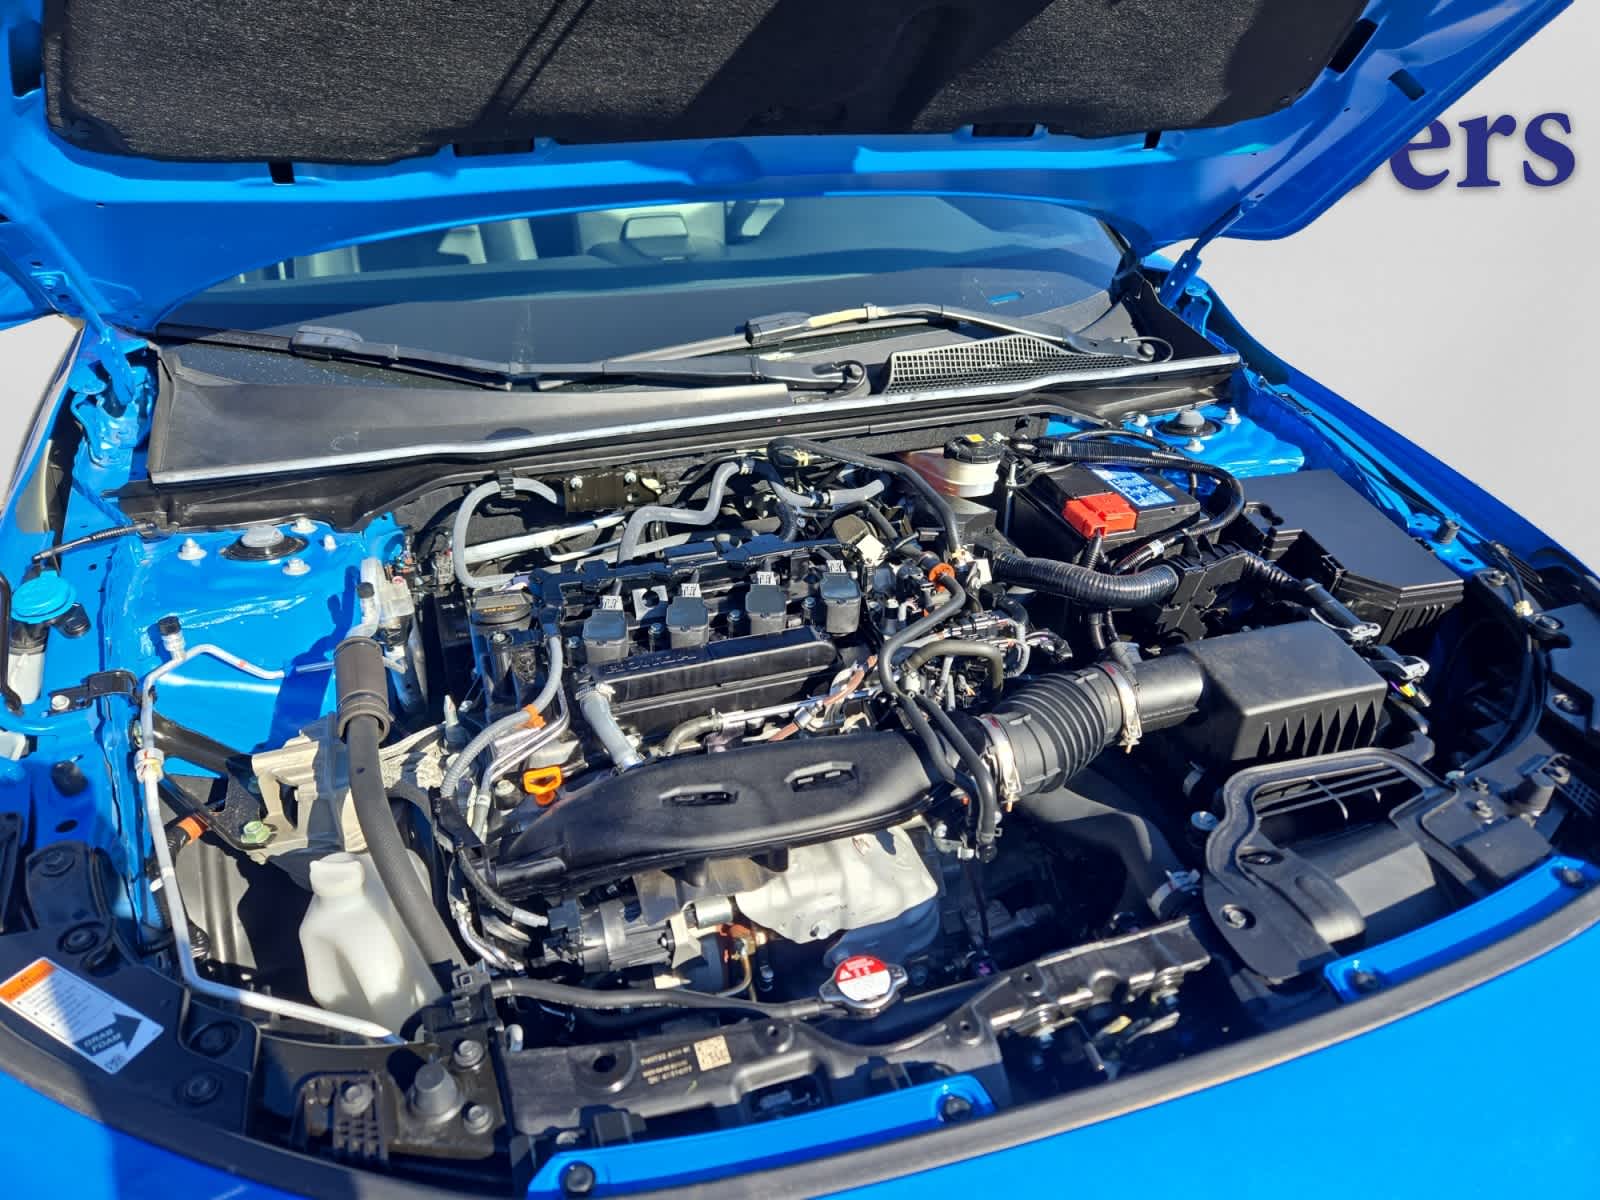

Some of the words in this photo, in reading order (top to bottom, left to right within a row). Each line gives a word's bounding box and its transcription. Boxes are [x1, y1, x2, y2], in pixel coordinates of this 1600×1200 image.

[1389, 112, 1575, 190] ers
[83, 1028, 114, 1047] GRAB
[92, 1033, 121, 1053] FOAM
